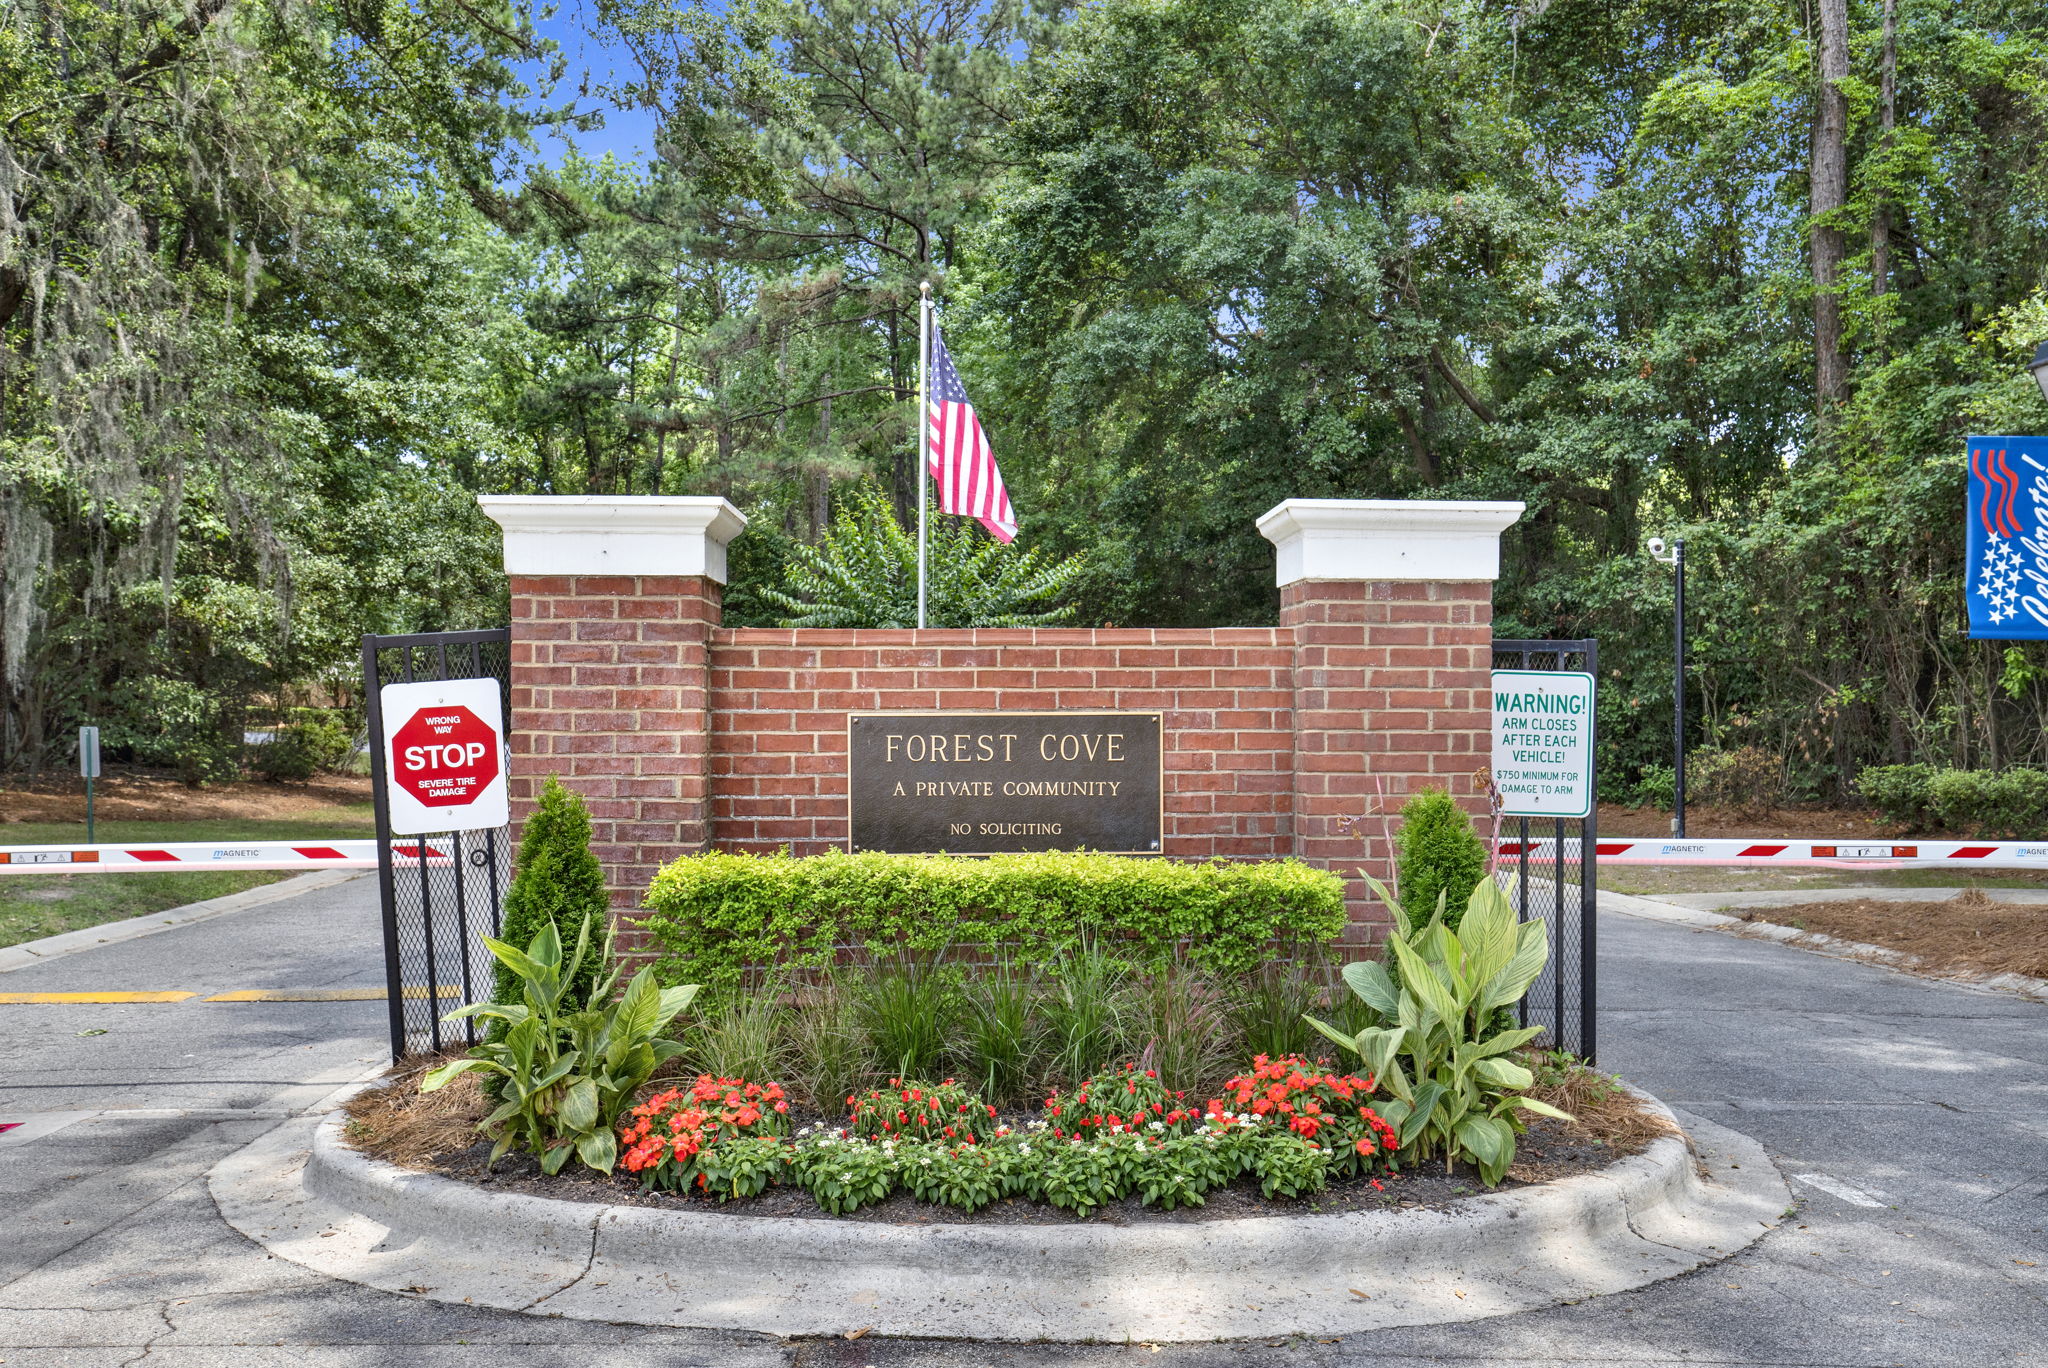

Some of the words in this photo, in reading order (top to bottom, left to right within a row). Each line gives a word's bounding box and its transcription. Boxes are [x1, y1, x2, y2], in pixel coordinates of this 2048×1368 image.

[1495, 692, 1586, 715] WARNING!
[425, 715, 461, 725] WRONG
[1502, 717, 1528, 730] ARM
[1531, 718, 1577, 731] CLOSES
[434, 726, 453, 734] WAY
[1502, 734, 1540, 746] AFTER
[1544, 735, 1577, 747] EACH
[885, 734, 1018, 762] FOREST
[1040, 733, 1126, 762] COVE
[404, 742, 486, 771] STOP
[1512, 750, 1565, 763] VEHICLE!
[1497, 769, 1520, 779] $750
[1522, 771, 1559, 781] MINIMUM
[1561, 772, 1579, 781] FOR
[418, 778, 454, 789] SEVERE
[455, 777, 477, 786] TIRE
[892, 782, 906, 797] A
[916, 781, 994, 797] PRIVATE
[1003, 781, 1121, 797] COMMUNITY
[1501, 783, 1538, 794] DAMAGE
[1540, 785, 1552, 794] TO
[1554, 785, 1573, 794] ARM
[429, 787, 467, 797] DAMAGE
[950, 823, 972, 835] NO
[980, 823, 1062, 836] SOLICITING
